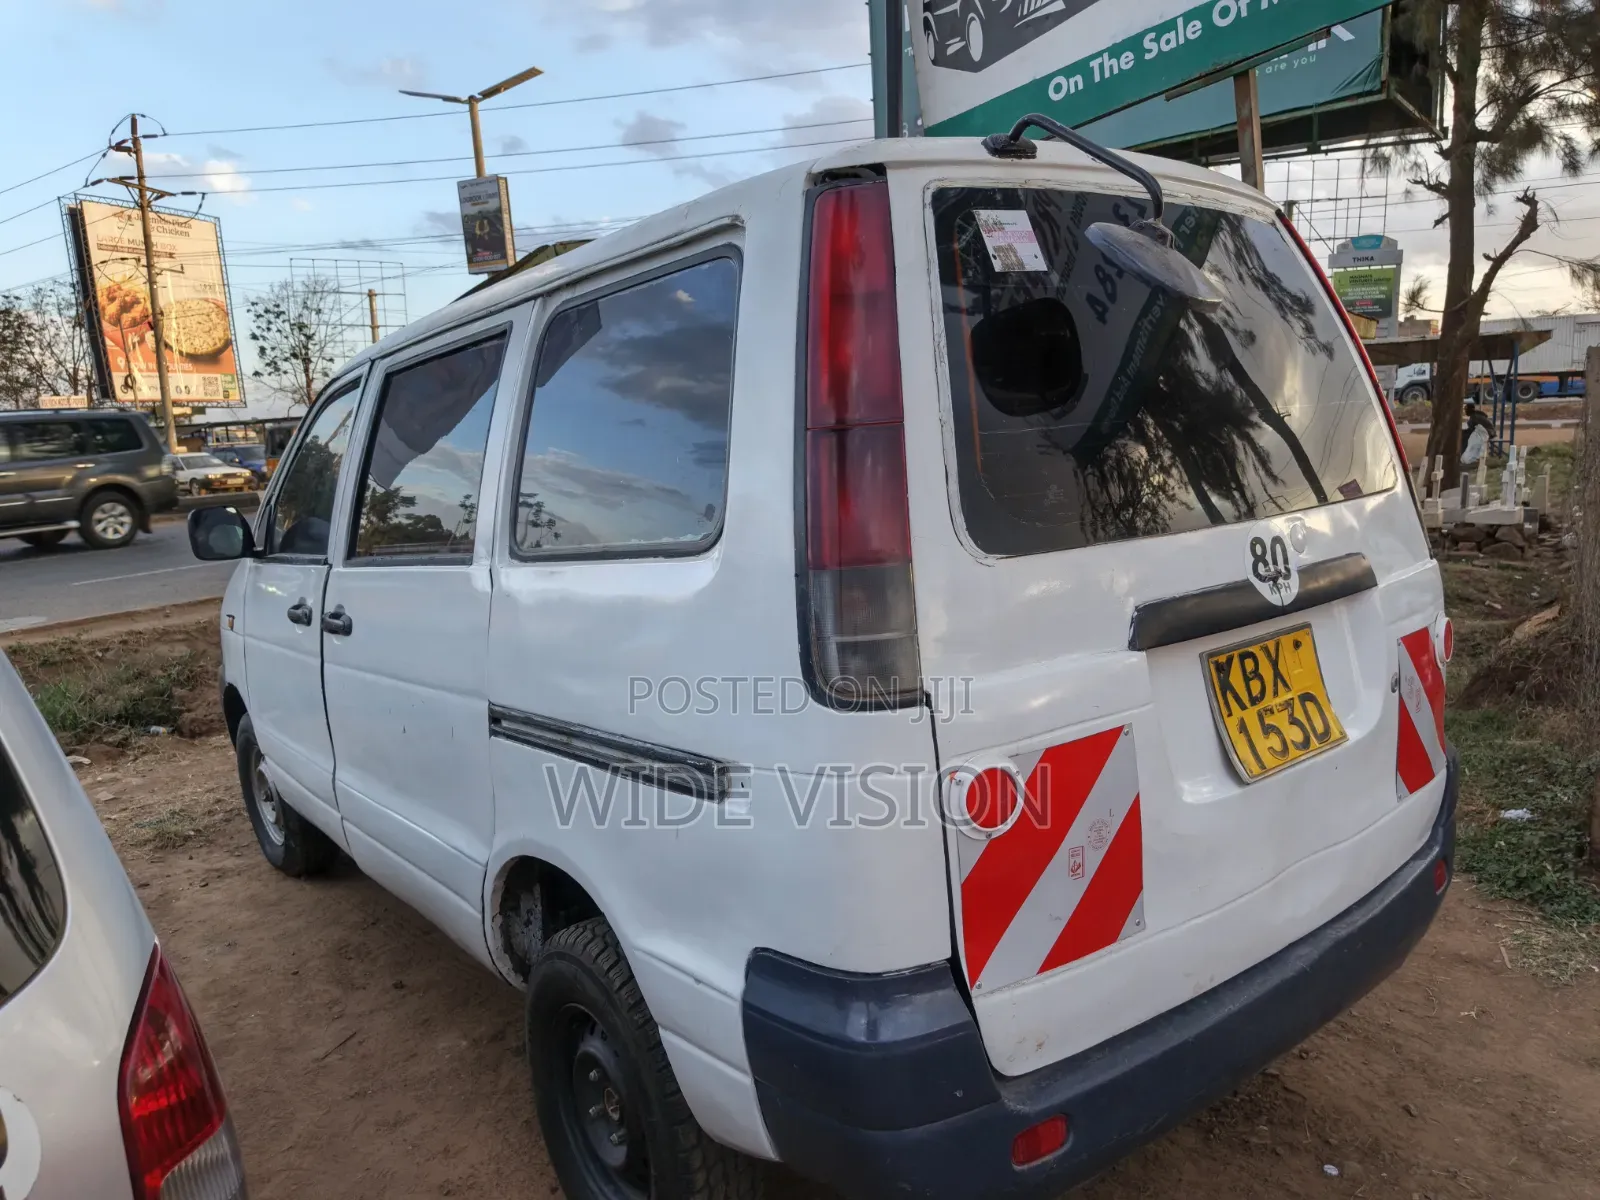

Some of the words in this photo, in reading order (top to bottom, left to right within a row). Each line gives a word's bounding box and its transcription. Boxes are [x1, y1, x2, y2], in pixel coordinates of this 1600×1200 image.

[1048, 75, 1083, 102] On
[1089, 50, 1134, 84] The
[1142, 16, 1202, 60] Sale
[1212, 0, 1248, 28] Of
[1265, 61, 1287, 75] are
[1290, 54, 1317, 71] you
[156, 225, 190, 238] Chicken
[127, 238, 158, 249] MUNH
[1352, 255, 1375, 263] THIKA
[1250, 534, 1292, 583] 80
[1266, 580, 1292, 597] KPH
[1213, 639, 1292, 718] KBX
[1236, 691, 1332, 771] 153D
